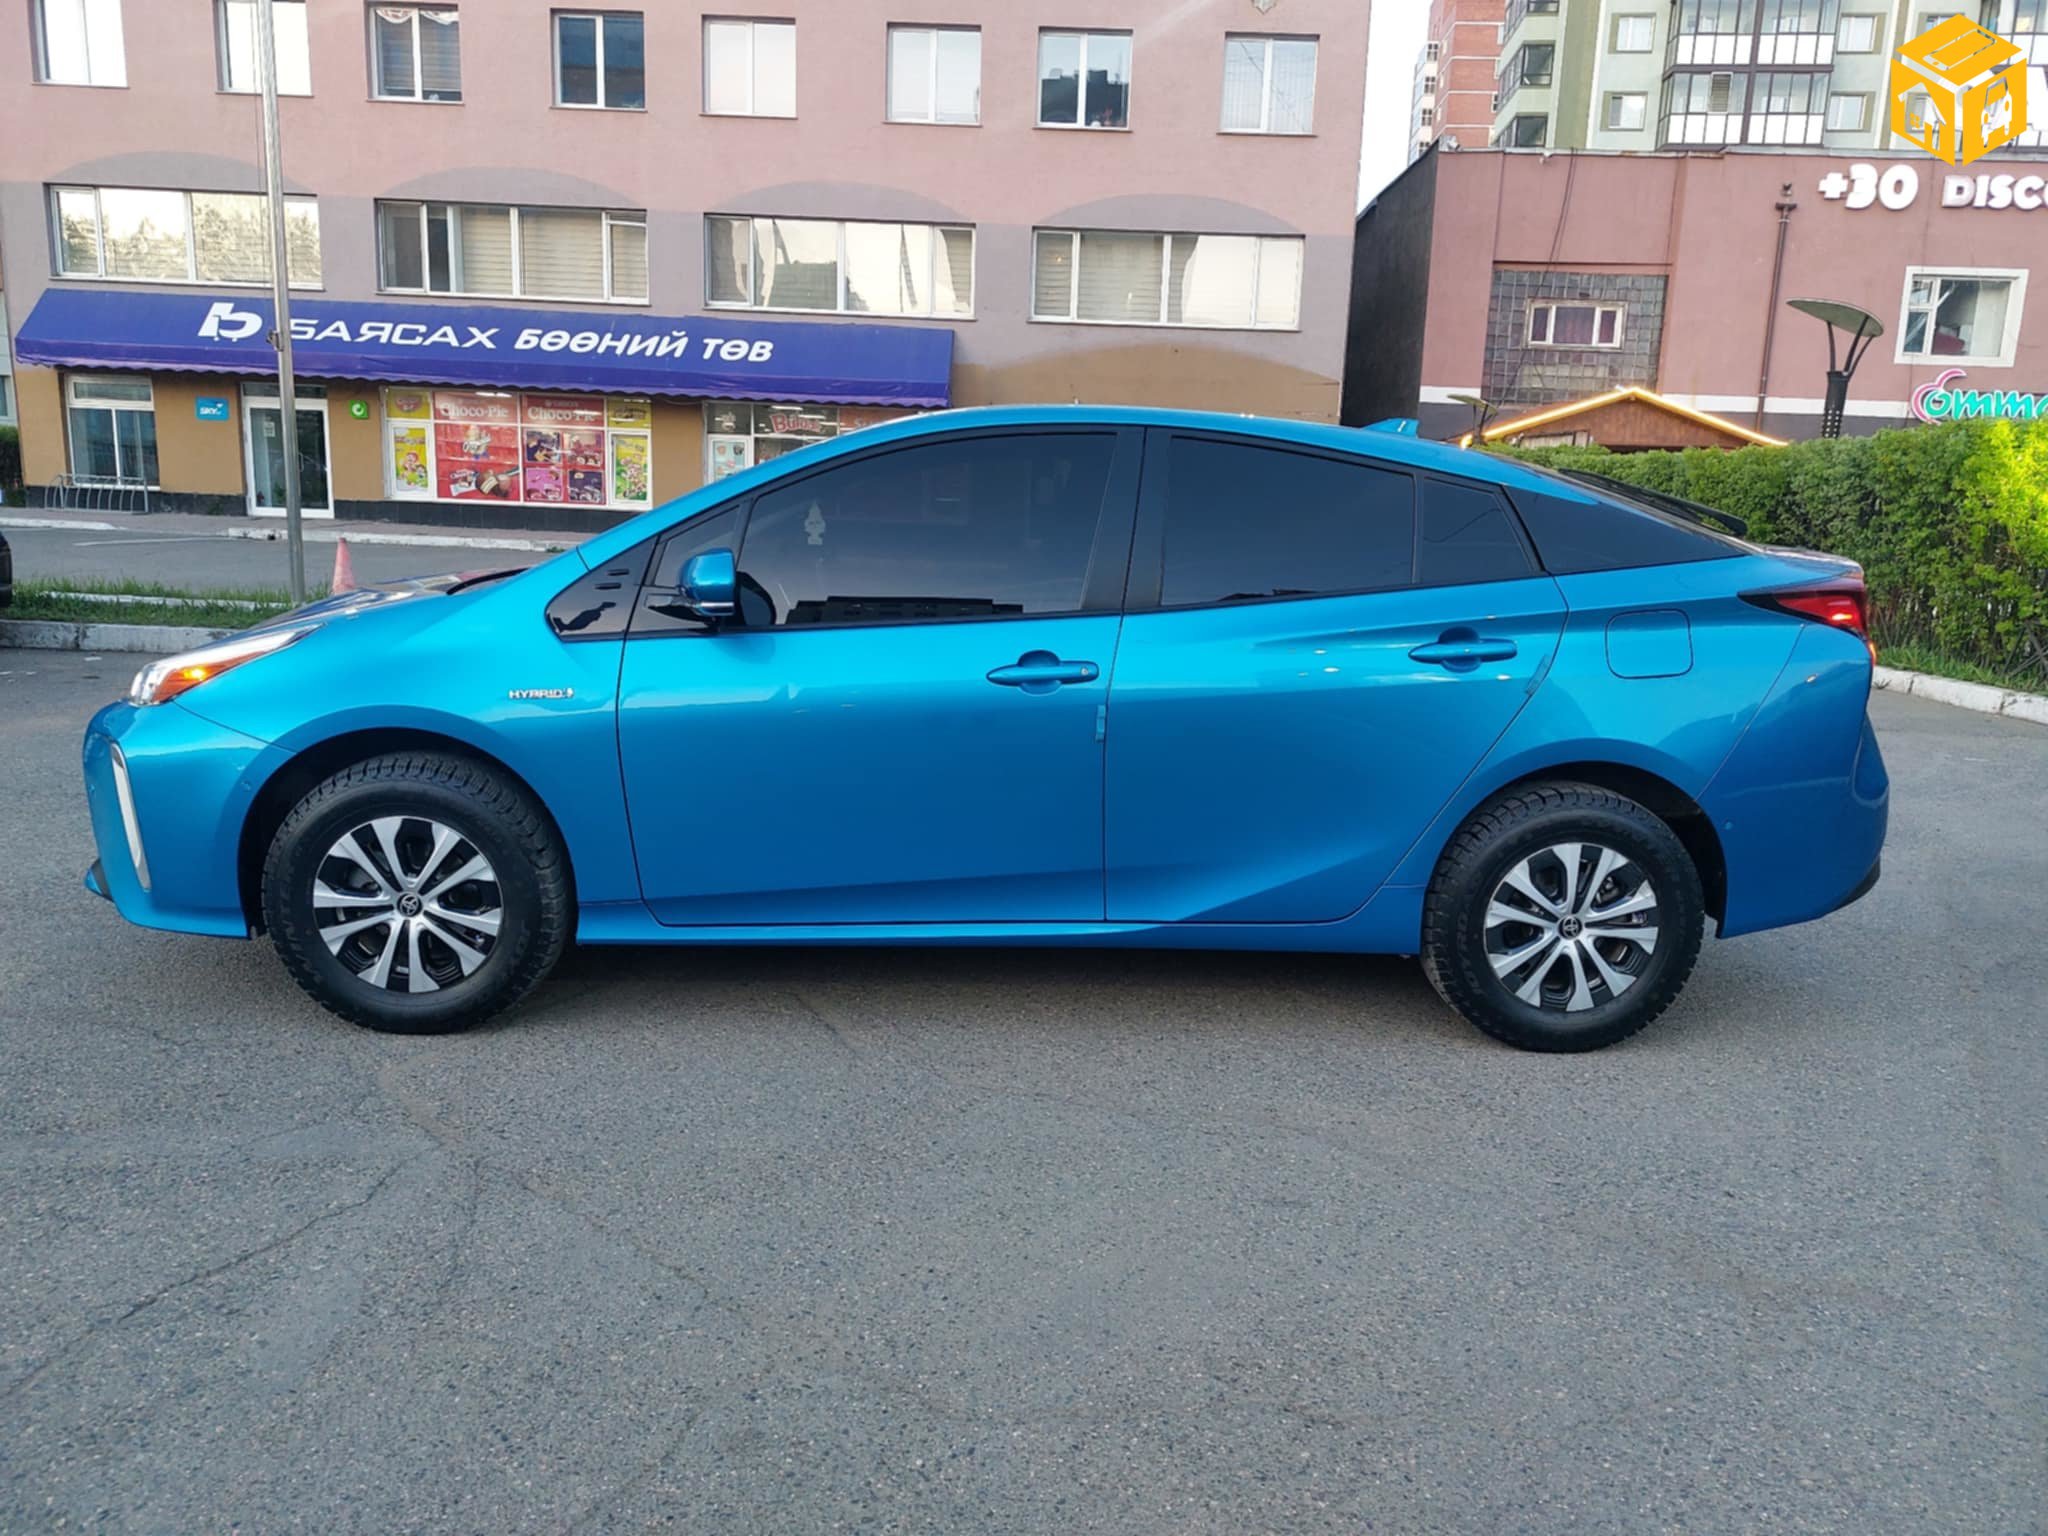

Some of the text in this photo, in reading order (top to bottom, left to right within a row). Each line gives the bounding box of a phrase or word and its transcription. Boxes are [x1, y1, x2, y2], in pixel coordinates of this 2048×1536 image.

[1818, 163, 2048, 210] +30 DISC
[288, 318, 774, 362] БАЯСАХ БӨӨНИЙ ТӨВ
